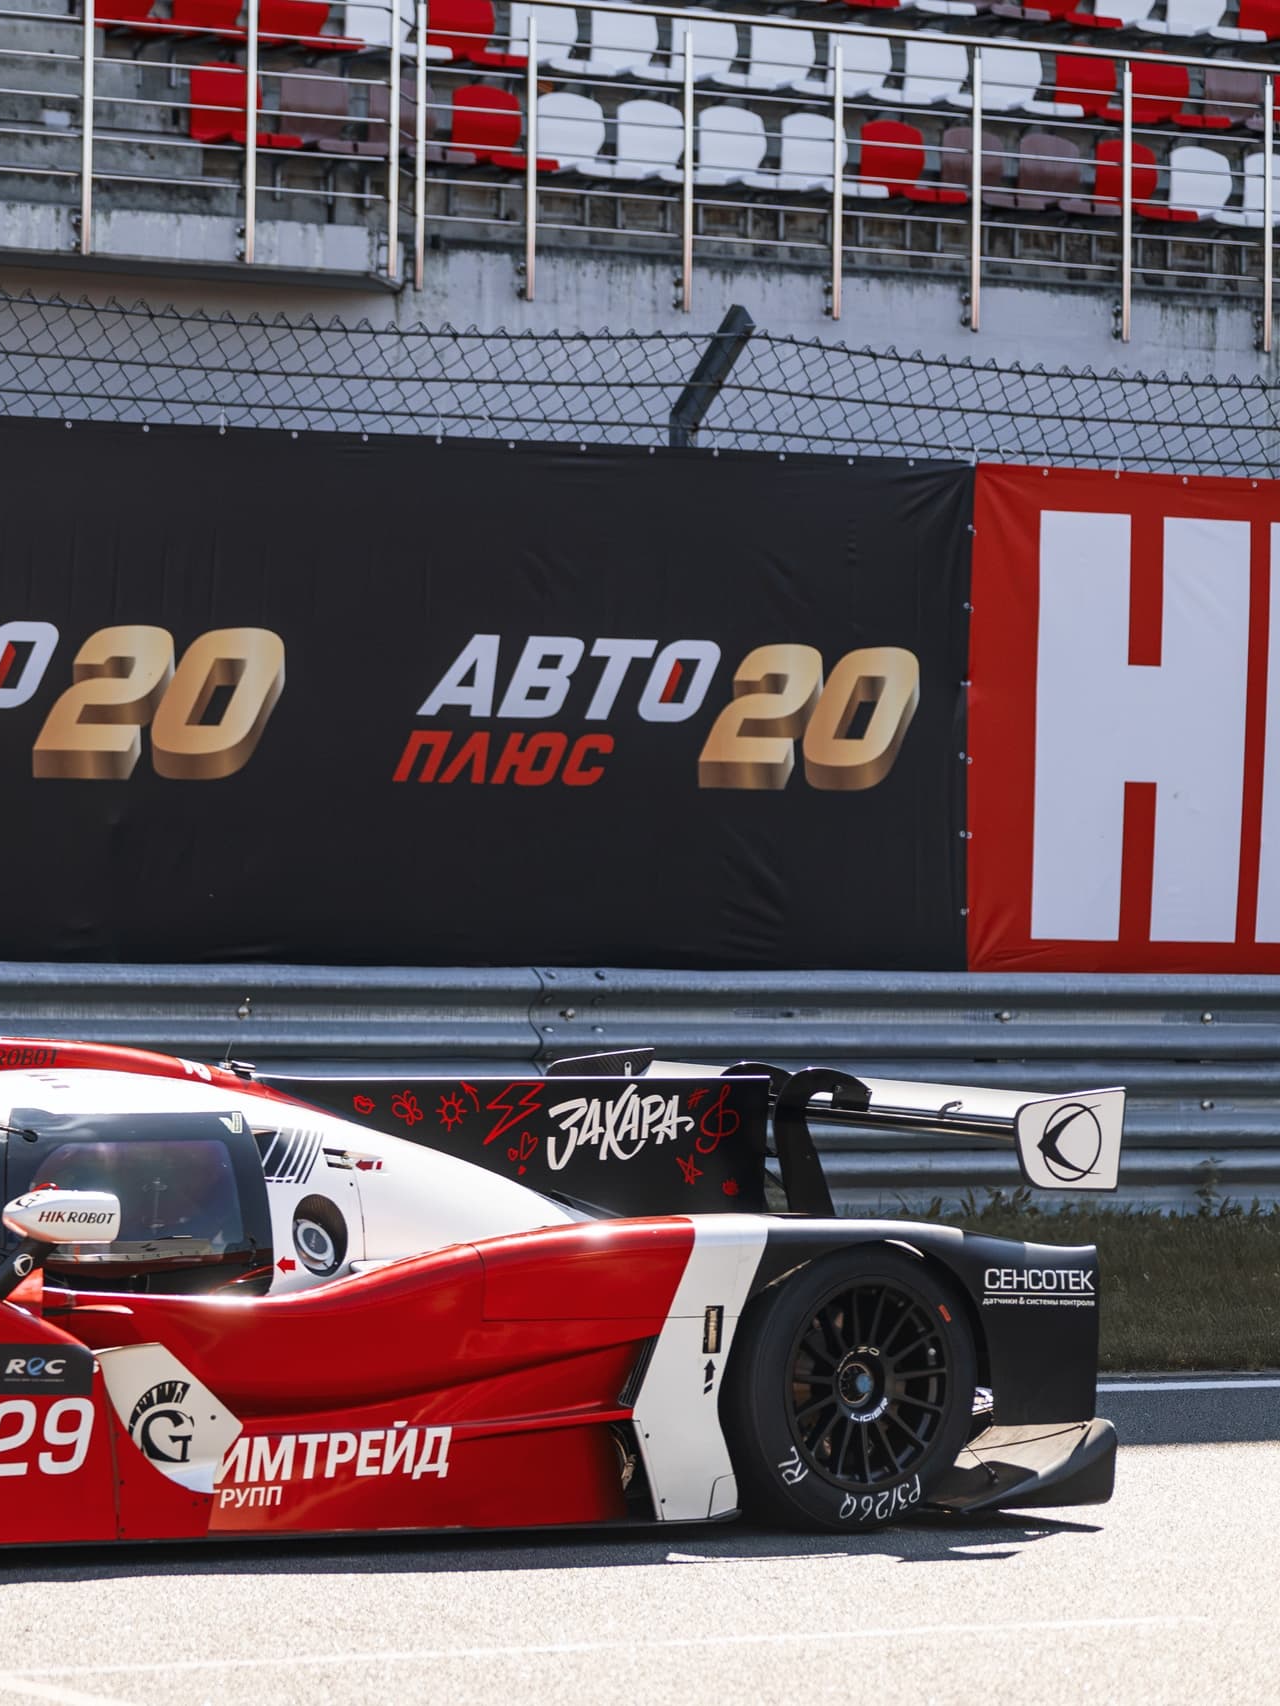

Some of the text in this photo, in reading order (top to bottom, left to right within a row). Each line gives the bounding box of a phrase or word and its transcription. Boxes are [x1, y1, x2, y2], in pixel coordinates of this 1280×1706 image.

[32, 624, 285, 780] 20
[416, 634, 920, 791] АВТО 20
[1030, 509, 1280, 943] Н
[392, 730, 614, 786] ПЛЮС
[38, 1210, 116, 1224] HIKROBOT
[984, 1268, 1095, 1290] СЕНСОТЕК
[213, 1421, 452, 1484] ИМТРЕЙД
[777, 1445, 809, 1485] RL
